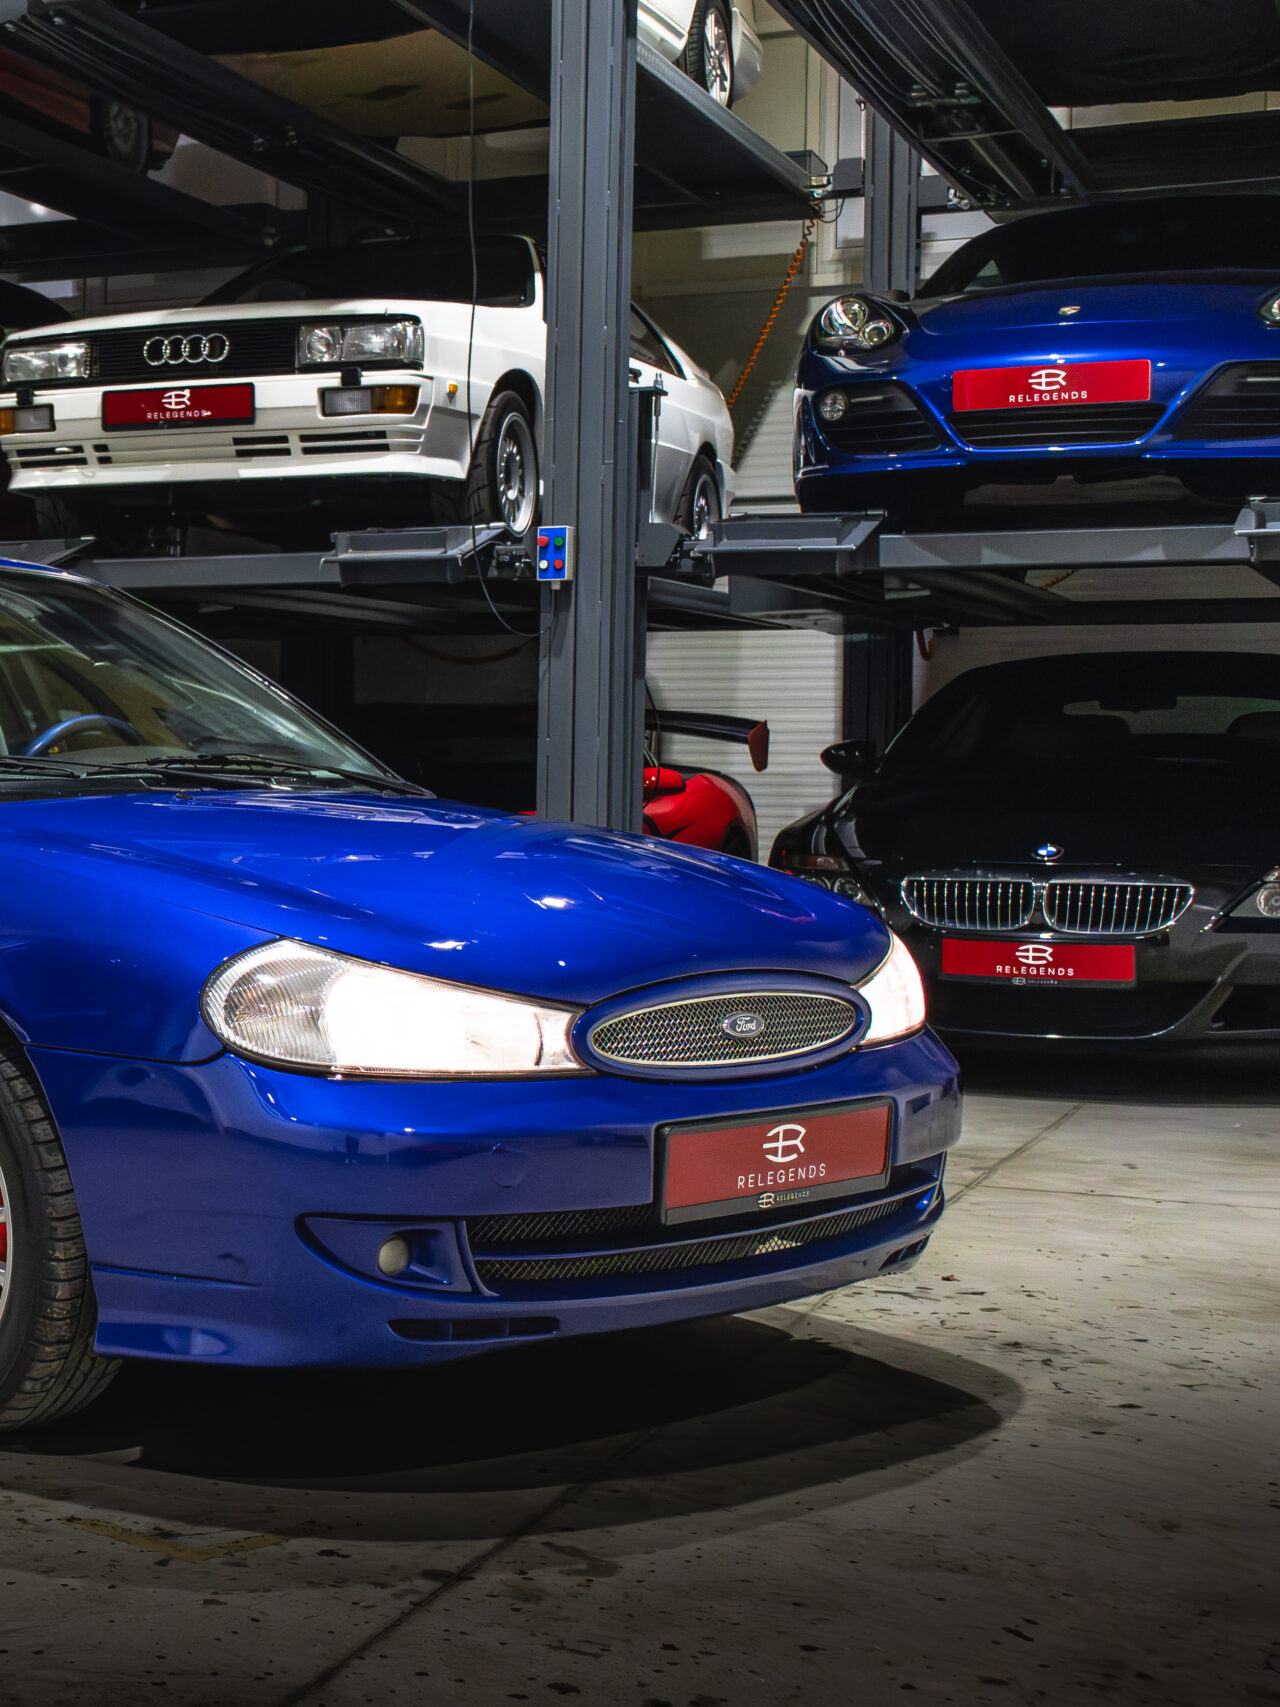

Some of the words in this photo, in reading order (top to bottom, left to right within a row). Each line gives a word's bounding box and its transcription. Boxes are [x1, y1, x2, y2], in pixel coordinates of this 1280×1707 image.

[1009, 391, 1088, 403] RELEGENDS
[147, 410, 207, 419] RELEGENDS
[996, 965, 1074, 976] RELEGENDS
[736, 1017, 757, 1032] Ford
[737, 1163, 826, 1189] RELEGENDS
